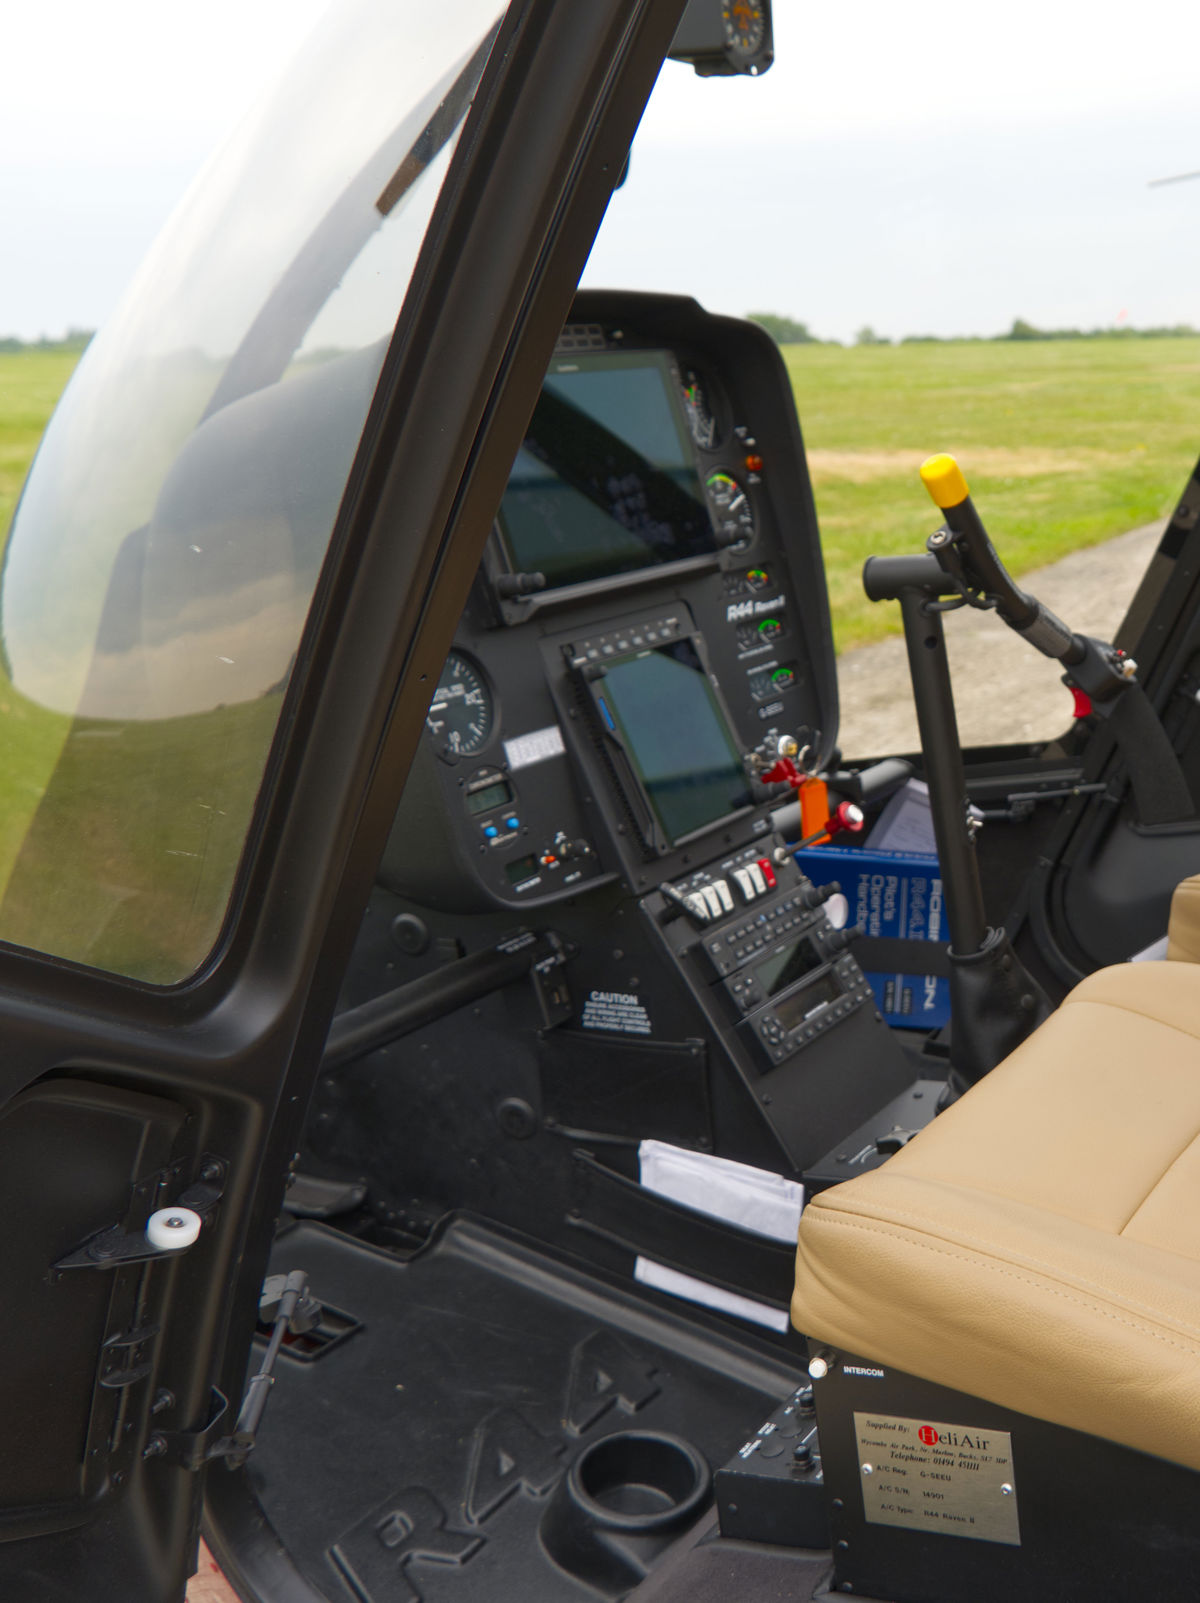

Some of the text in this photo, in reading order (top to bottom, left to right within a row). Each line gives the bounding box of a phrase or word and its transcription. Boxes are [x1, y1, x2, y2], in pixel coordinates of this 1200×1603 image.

[856, 873, 871, 928] Handb
[869, 874, 884, 938] Operati
[883, 875, 898, 921] Pilot's
[591, 991, 638, 1005] CAUTION
[843, 1365, 885, 1377] INTERCOM
[865, 1420, 897, 1431] Supplied
[898, 1425, 911, 1433] By:
[861, 1438, 888, 1447] Wycombe
[324, 1328, 664, 1603] R44
[890, 1450, 931, 1463] Telephone:
[933, 1457, 955, 1467] 01494
[876, 1464, 890, 1473] A/C
[919, 1470, 952, 1481] G-SEEU
[878, 1484, 892, 1493] A/C
[922, 1490, 944, 1500] 14901
[880, 1503, 894, 1512] A/C
[923, 1509, 939, 1518] R44
[942, 1512, 966, 1522] Raven
